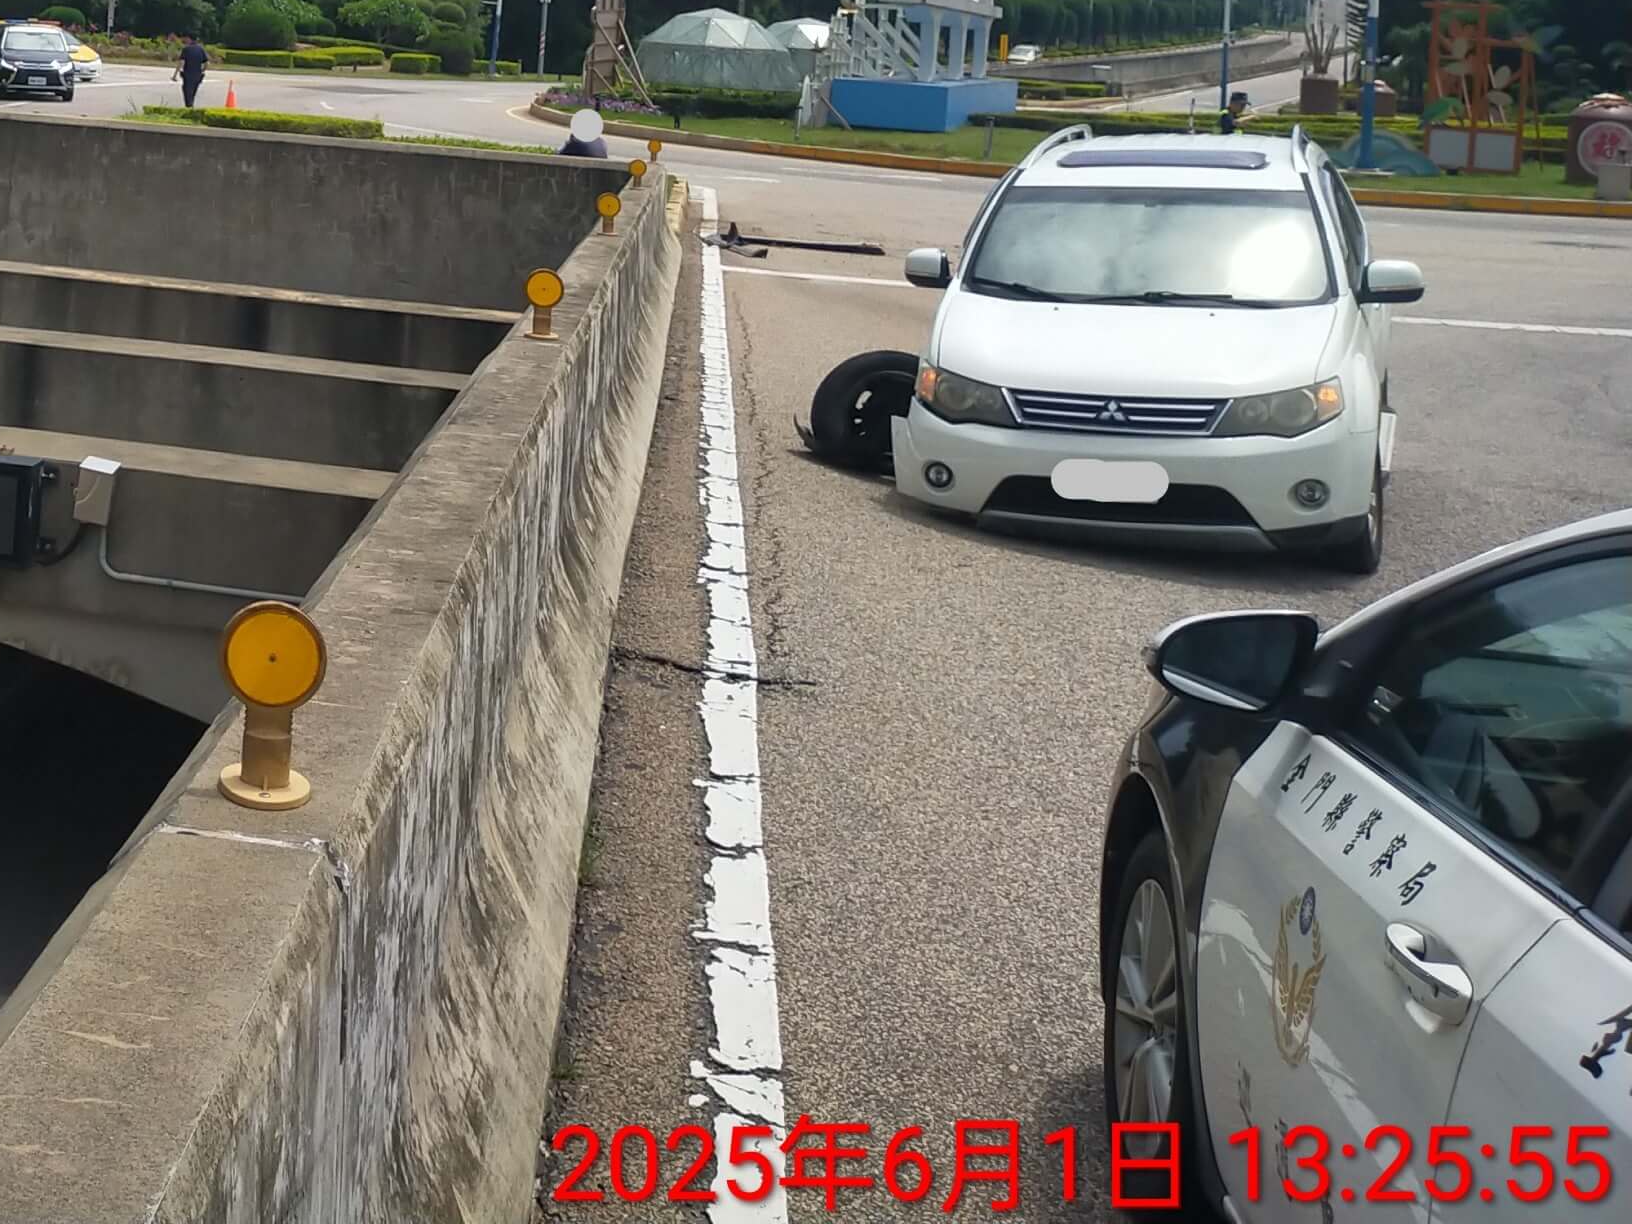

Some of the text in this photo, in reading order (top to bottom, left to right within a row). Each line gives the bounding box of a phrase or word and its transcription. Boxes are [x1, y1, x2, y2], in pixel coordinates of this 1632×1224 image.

[1280, 752, 1437, 907] 金門縣警察局
